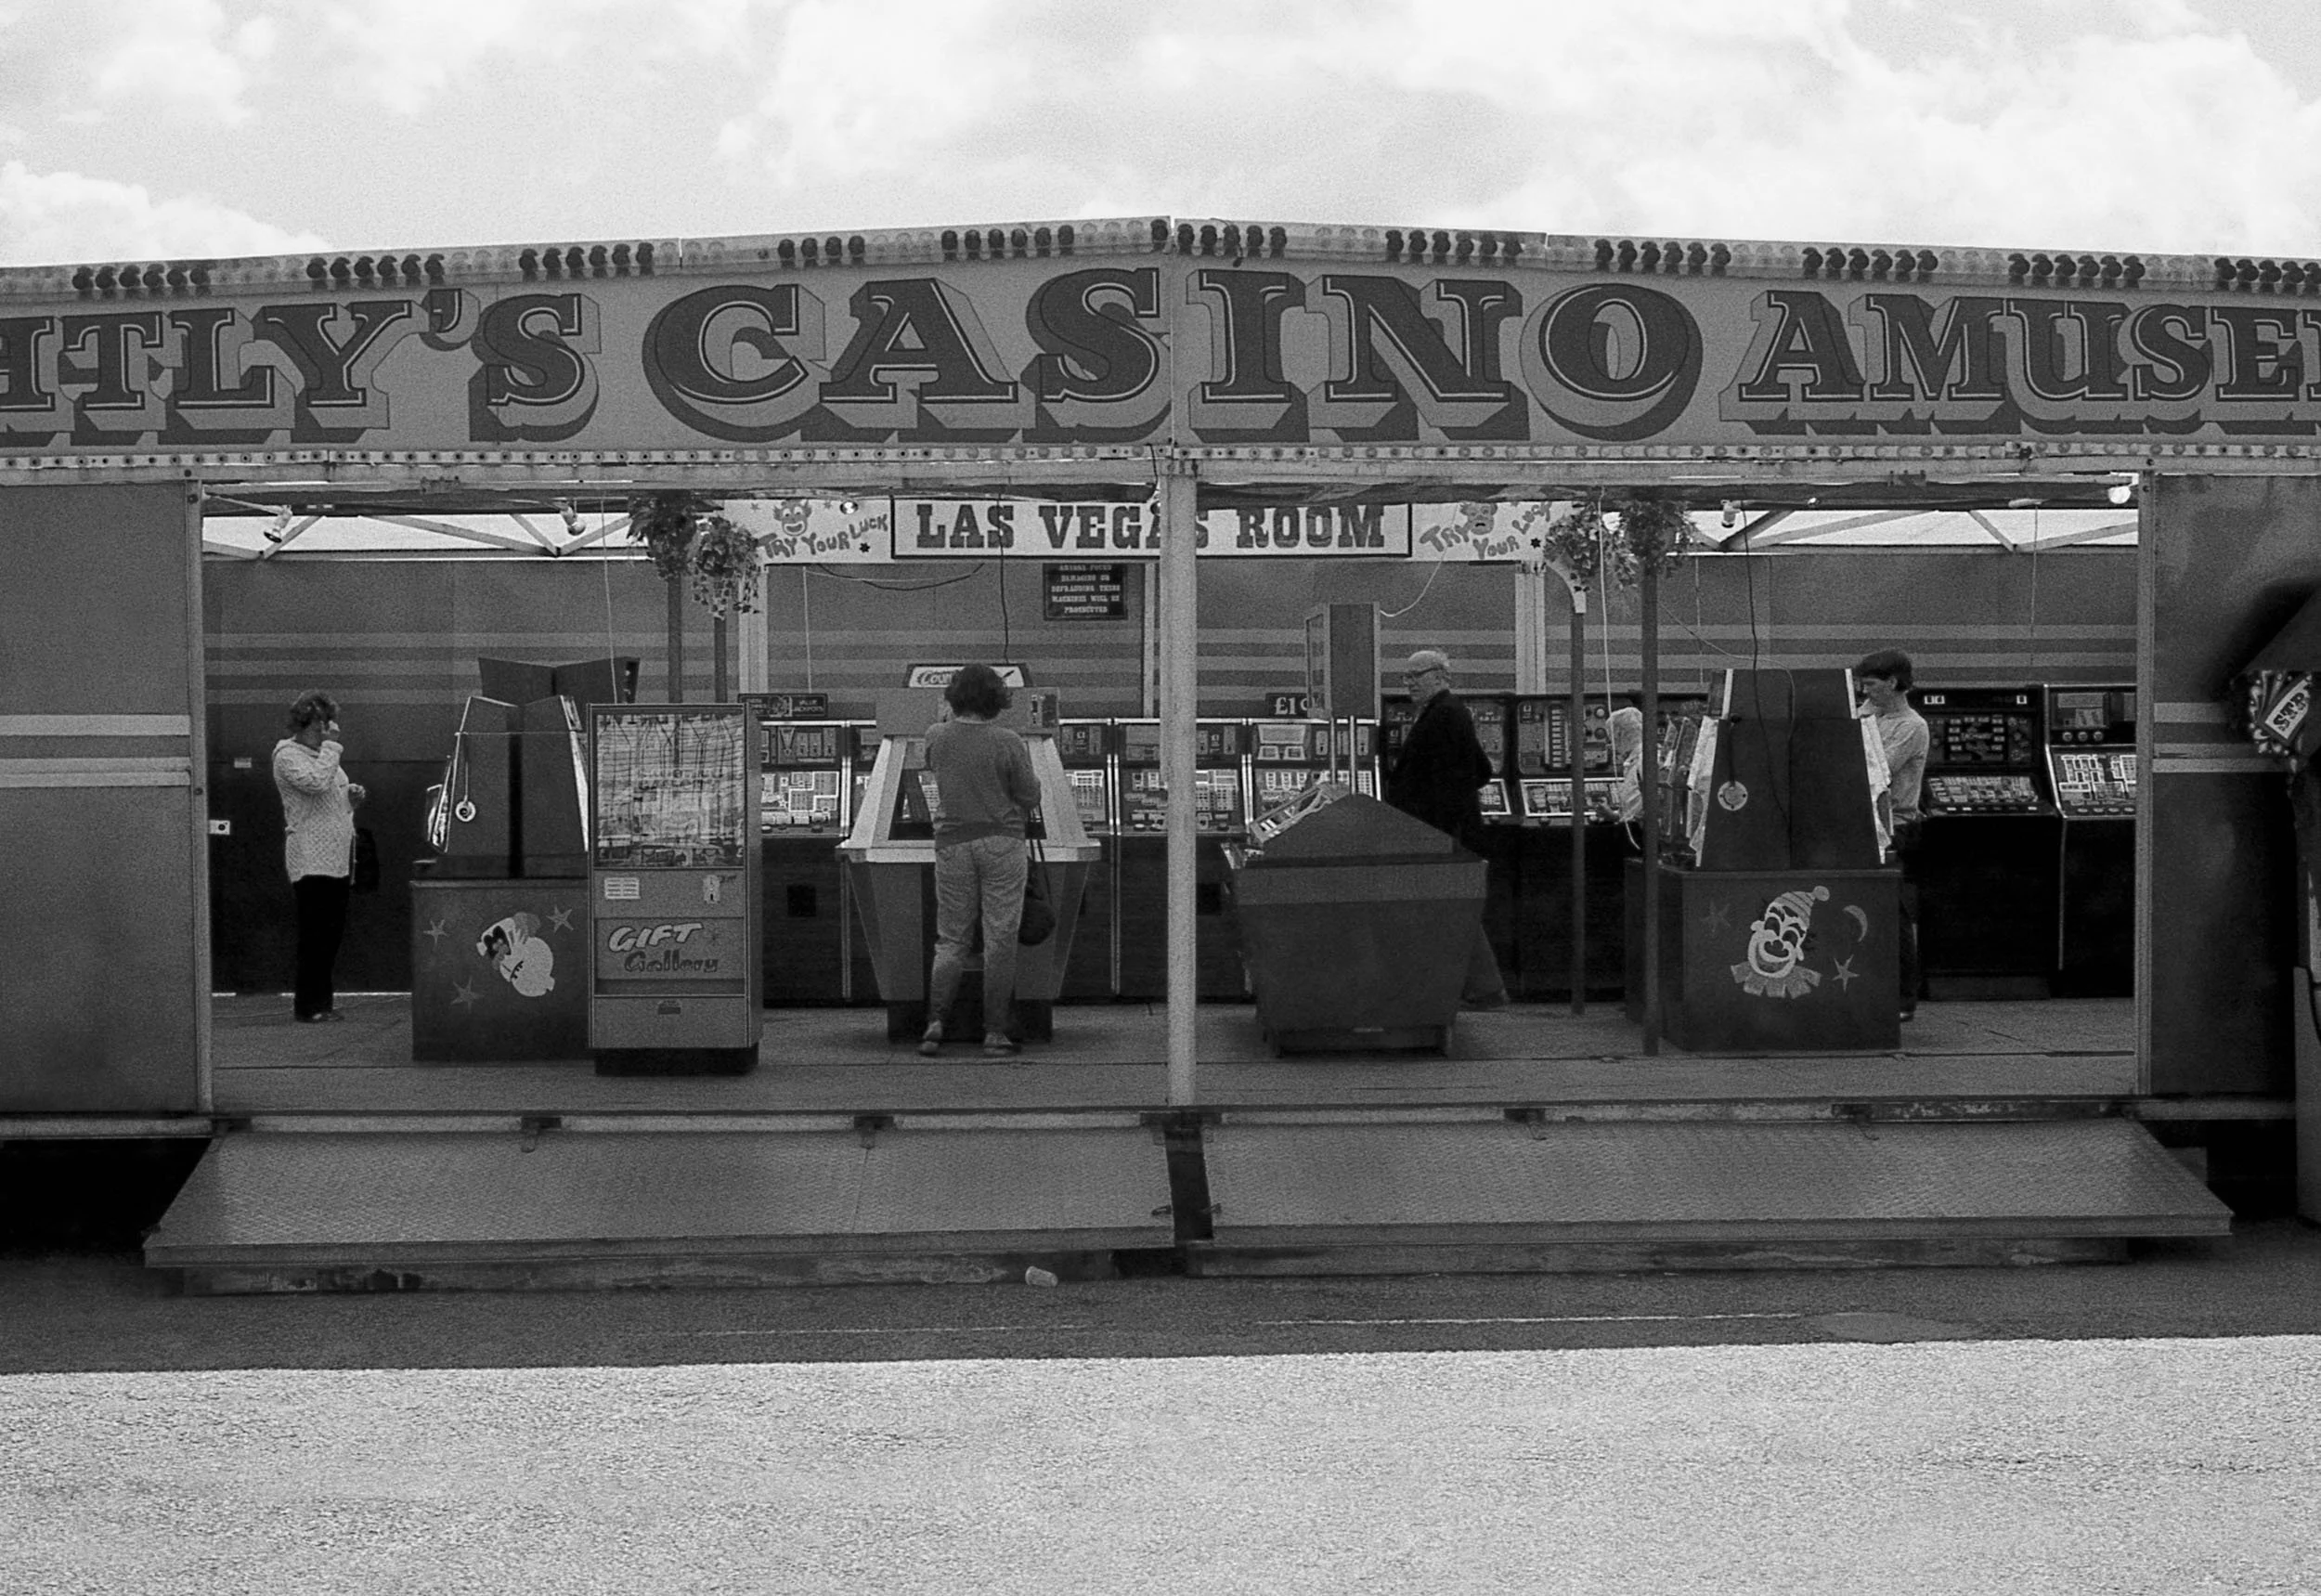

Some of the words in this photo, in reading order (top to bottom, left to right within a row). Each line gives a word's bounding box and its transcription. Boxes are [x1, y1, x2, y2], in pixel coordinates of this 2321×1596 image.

[642, 266, 1704, 443] CASINO
[1719, 290, 2321, 435] AMUSE
[756, 532, 797, 558] TRY
[800, 532, 850, 555] YOUR
[849, 513, 888, 539] LUCK
[916, 504, 1015, 549] LAS
[1236, 505, 1384, 549] ROOM
[1420, 526, 1473, 552] TRY
[1472, 538, 1520, 560] YOUR
[1275, 696, 1296, 715] £1
[609, 922, 704, 953] GIFT
[624, 950, 719, 972] Gallery
